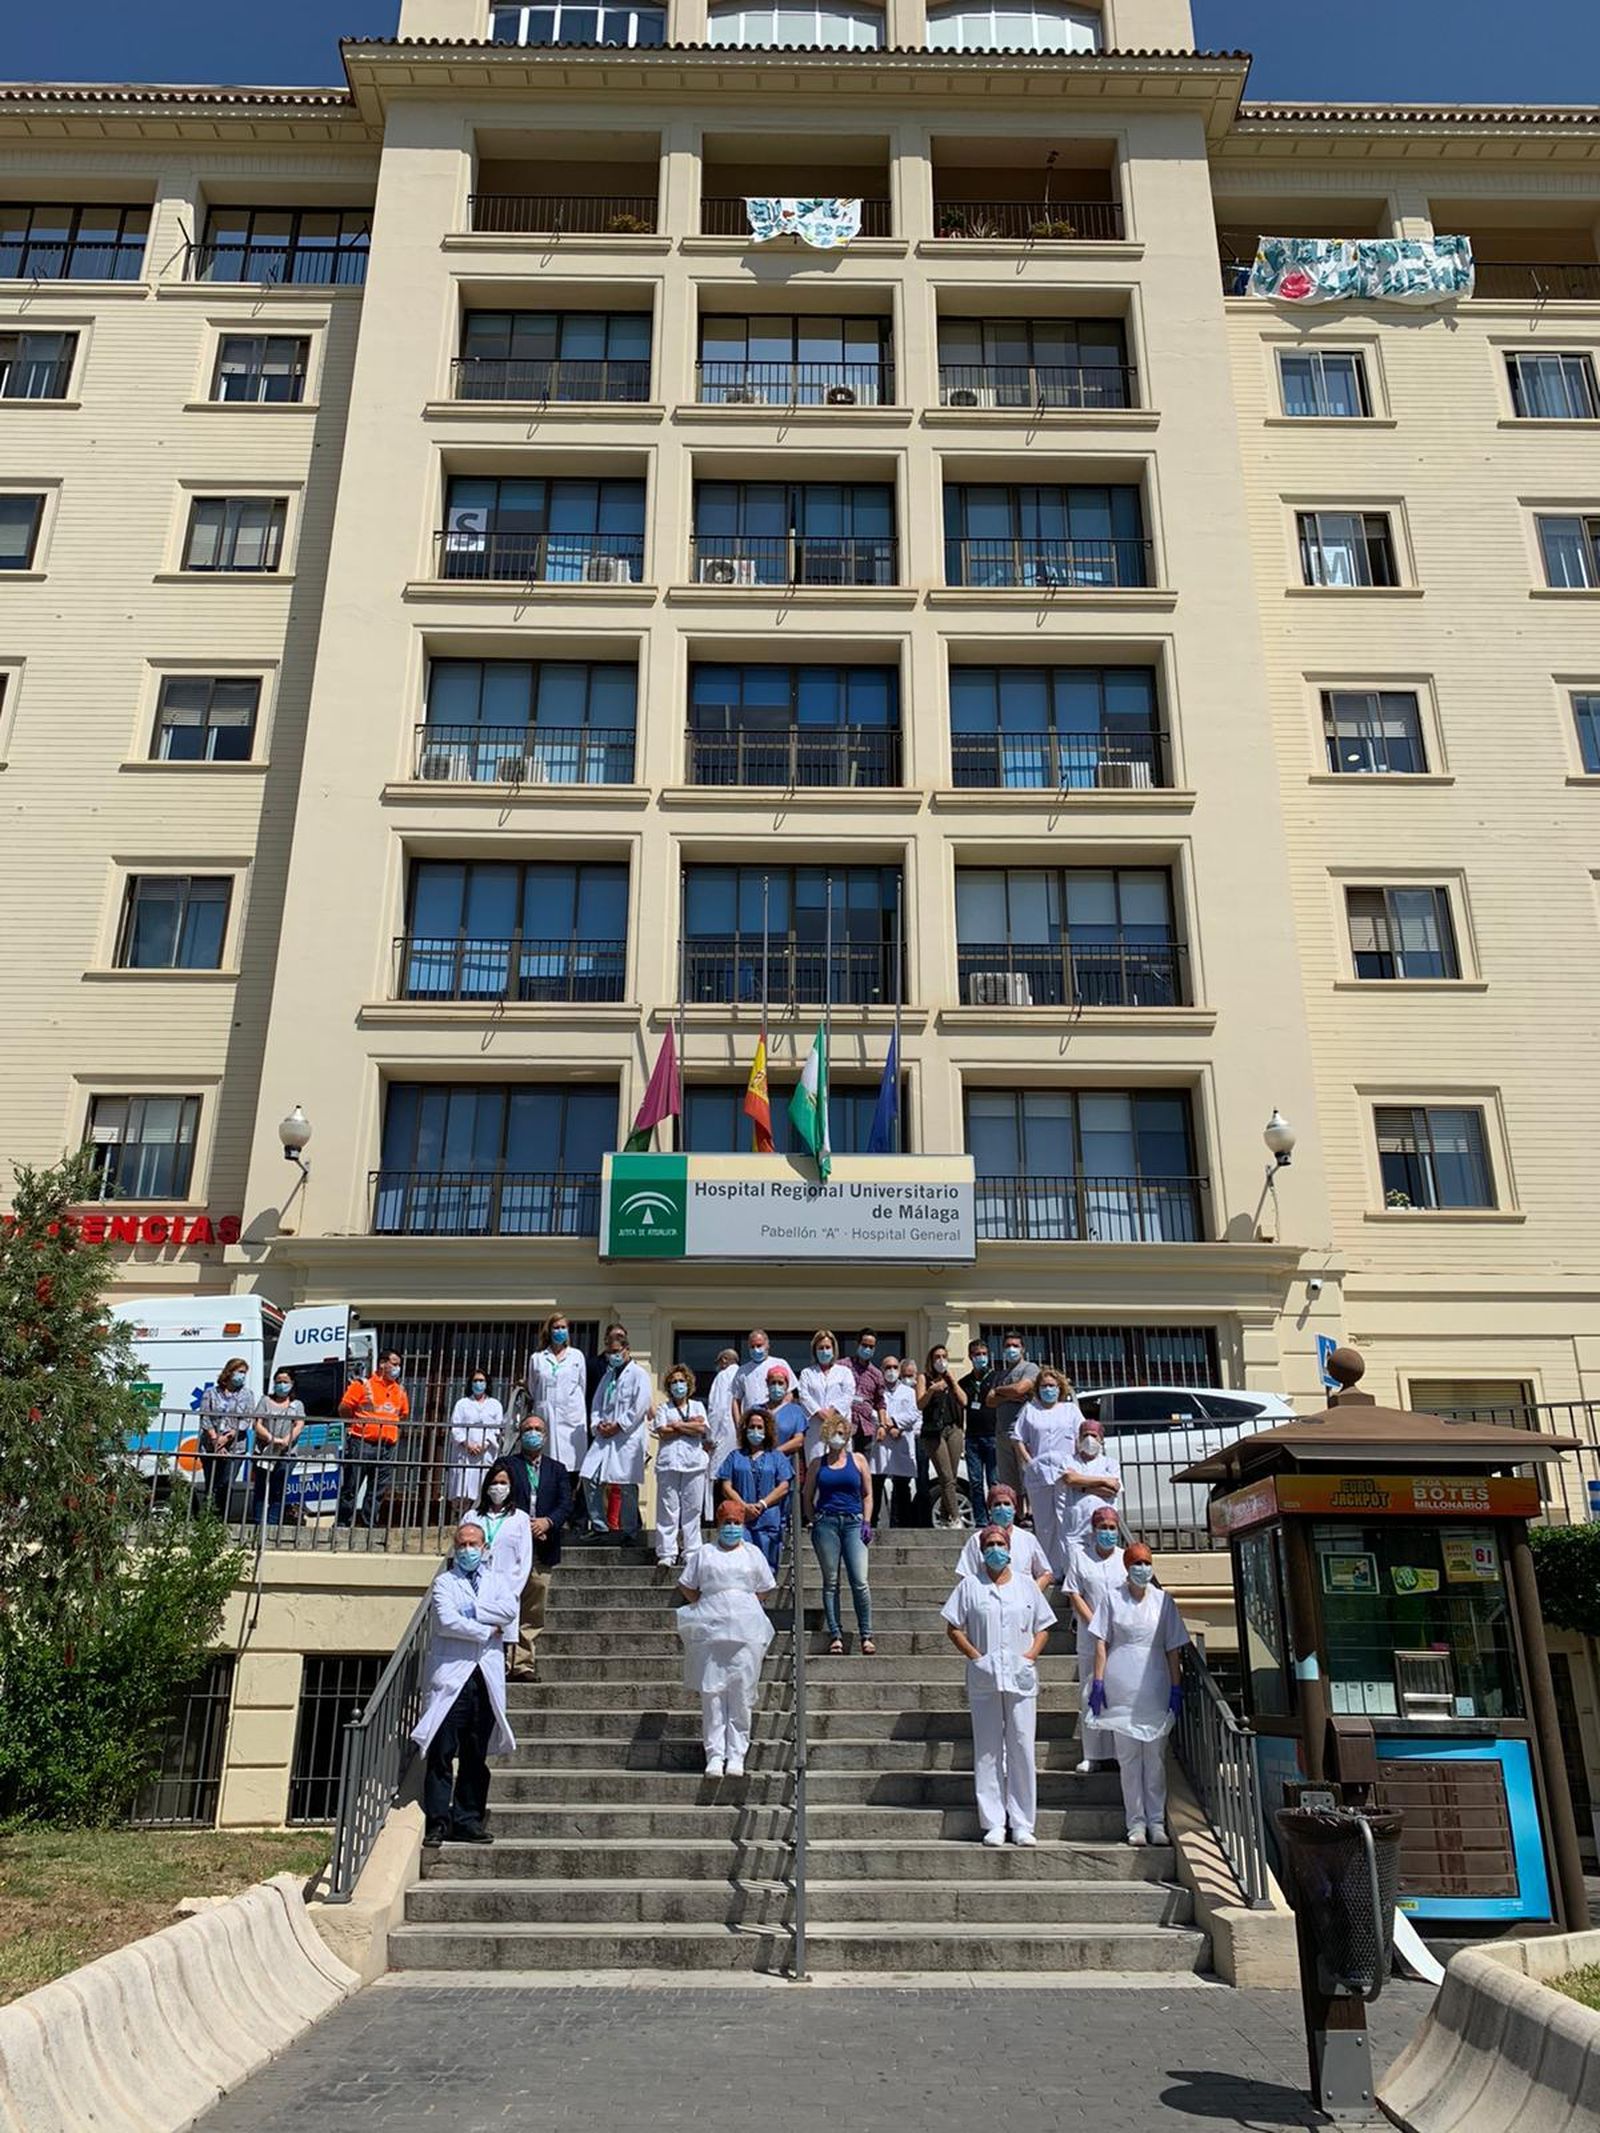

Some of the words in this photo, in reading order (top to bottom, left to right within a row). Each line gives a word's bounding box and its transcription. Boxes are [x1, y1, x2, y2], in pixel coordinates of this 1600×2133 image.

[694, 1182, 765, 1199] Hospital
[771, 1182, 844, 1201] Regional
[850, 1183, 960, 1199] Universitario
[872, 1205, 893, 1219] de
[899, 1204, 960, 1223] Málaga
[760, 1225, 817, 1239] Pabellón
[852, 1228, 906, 1242] Hospital
[910, 1228, 962, 1241] General
[294, 1325, 346, 1345] URGE
[1330, 1491, 1389, 1507] JACKPOT
[1413, 1487, 1489, 1500] BOTES
[1414, 1501, 1490, 1510] MILLONARIOS
